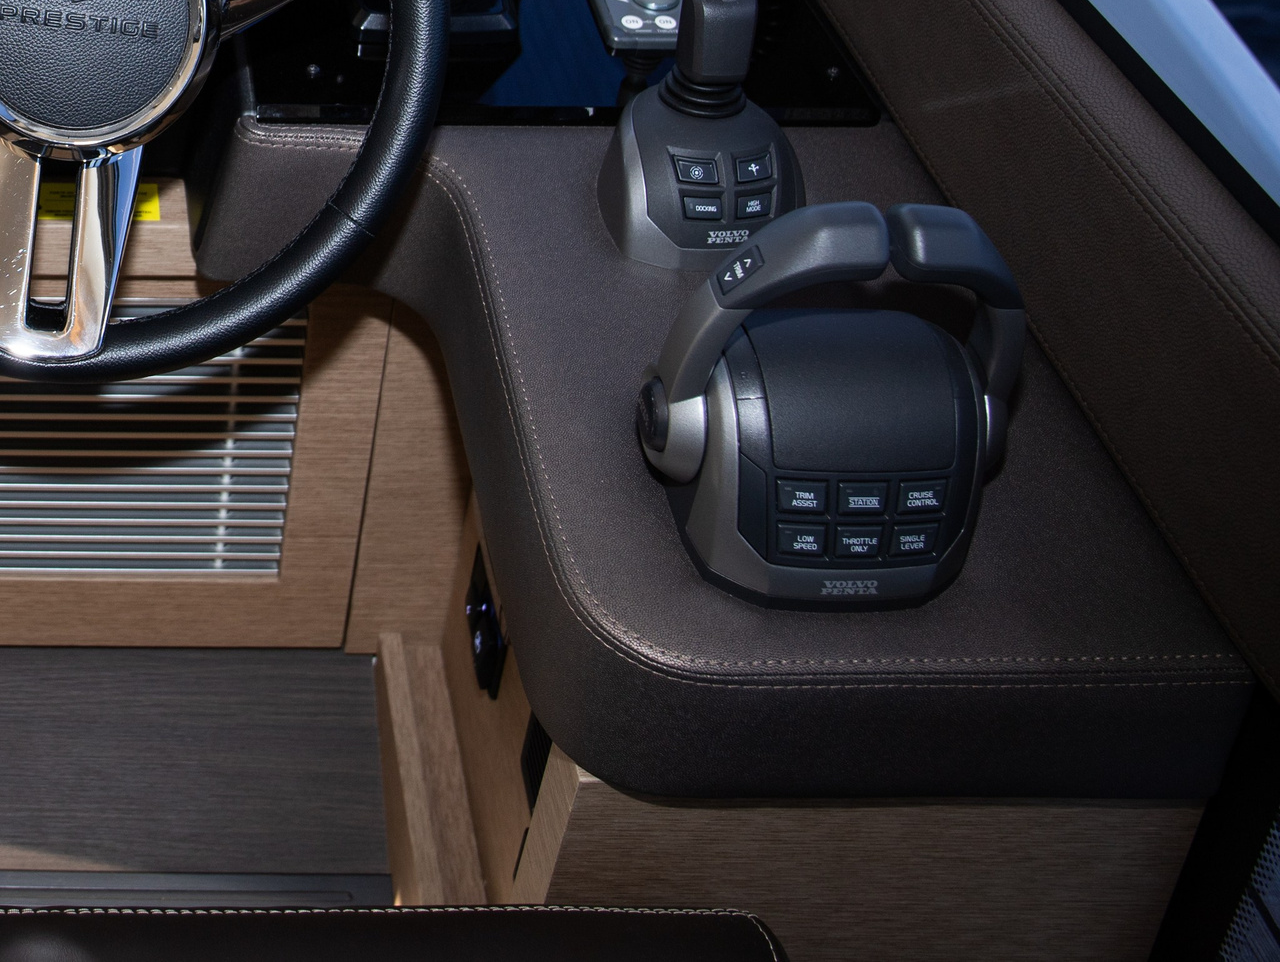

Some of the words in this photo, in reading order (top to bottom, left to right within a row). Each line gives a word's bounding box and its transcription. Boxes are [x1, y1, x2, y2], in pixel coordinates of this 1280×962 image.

[745, 205, 762, 213] MODE
[708, 229, 750, 238] VOLVO
[706, 236, 749, 244] PENTA
[733, 261, 745, 279] TRIM
[795, 491, 814, 500] TRIM
[908, 491, 934, 499] CRUISE
[791, 499, 818, 507] ASSIST
[848, 498, 879, 506] STATION
[907, 499, 939, 507] CONTROL
[797, 535, 815, 543] LOW
[842, 537, 878, 545] THROTTLE
[899, 535, 926, 543] SINGLE
[793, 542, 818, 550] SPEED
[900, 542, 925, 550] LEVER
[823, 580, 878, 588] VOLVO
[820, 587, 879, 595] PENTA
